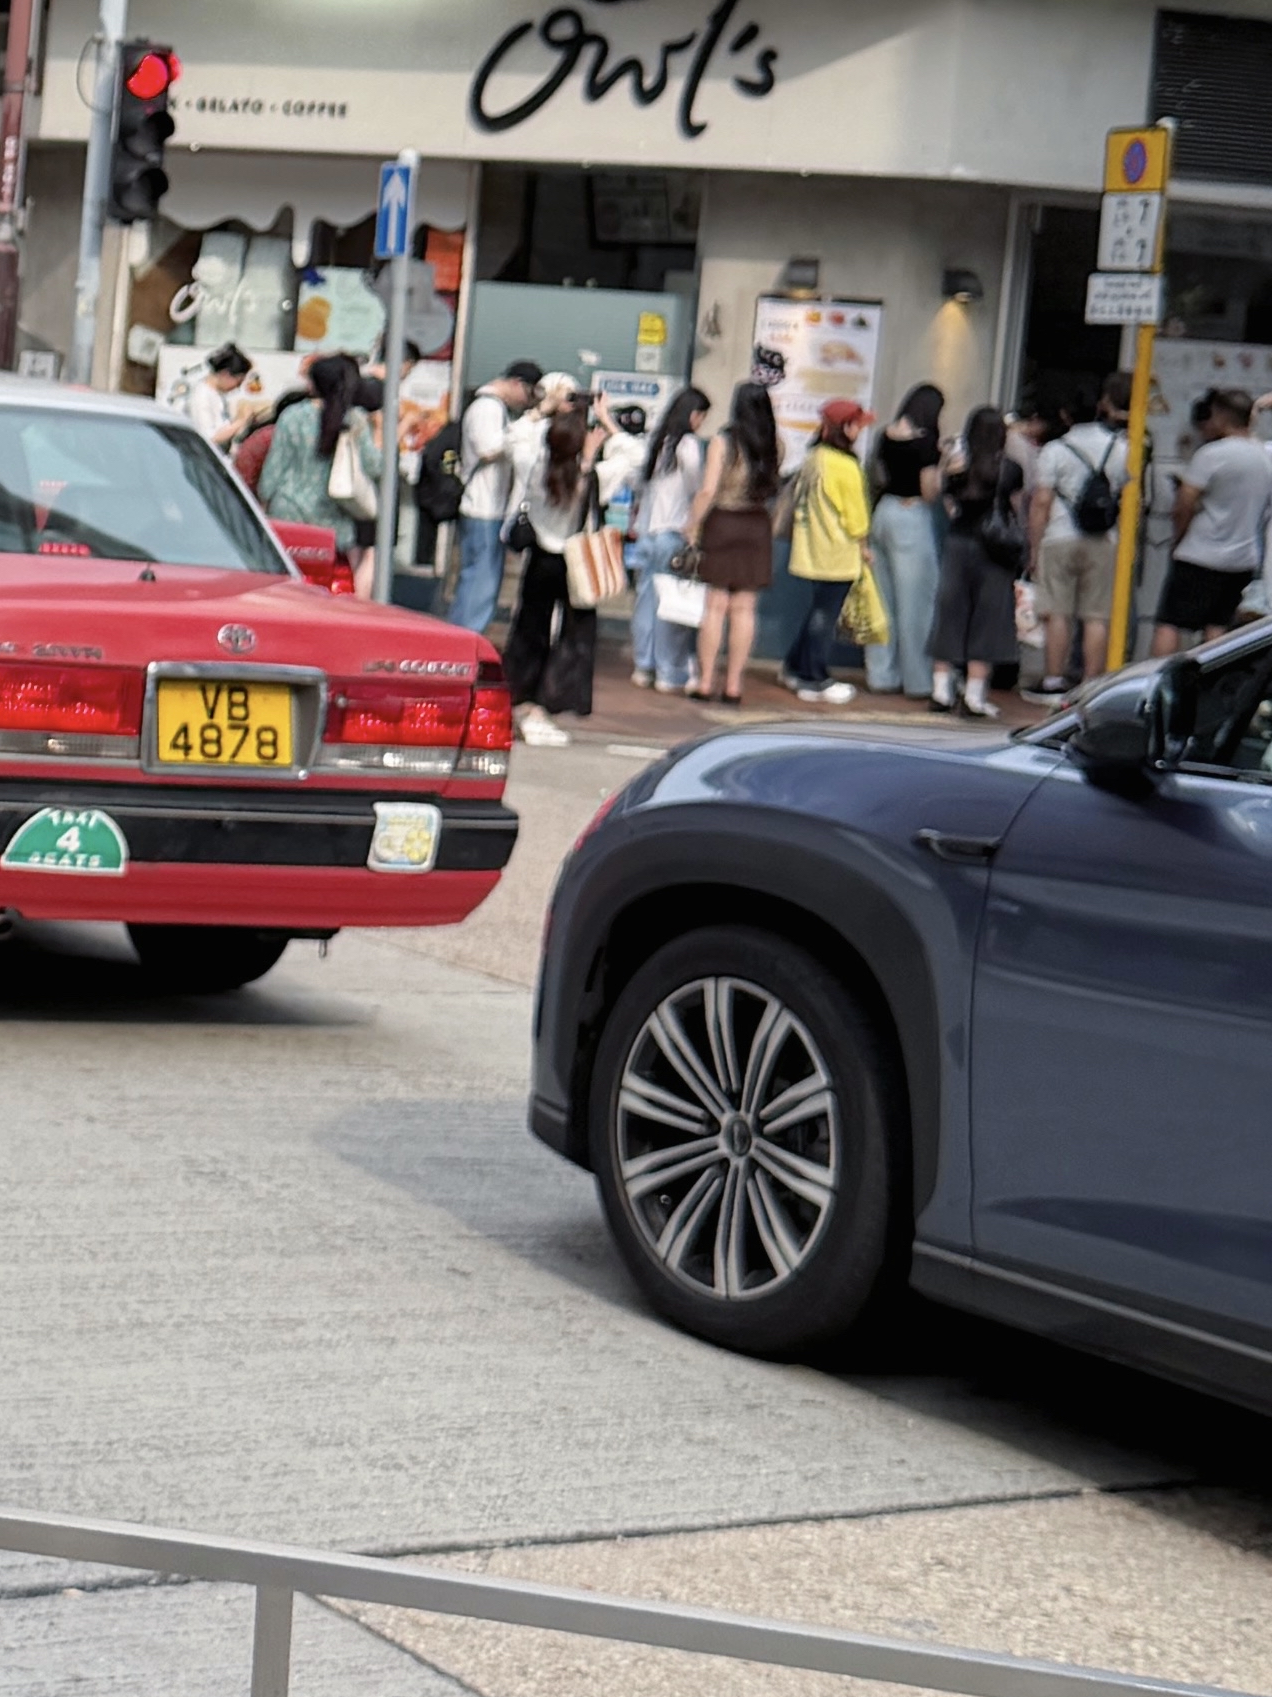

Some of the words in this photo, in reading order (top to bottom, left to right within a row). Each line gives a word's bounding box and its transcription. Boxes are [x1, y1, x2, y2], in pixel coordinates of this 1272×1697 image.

[196, 97, 264, 115] GELATO
[282, 101, 347, 118] COFFEE
[199, 685, 250, 722] VB
[169, 723, 278, 761] 4878
[56, 826, 81, 853] 4
